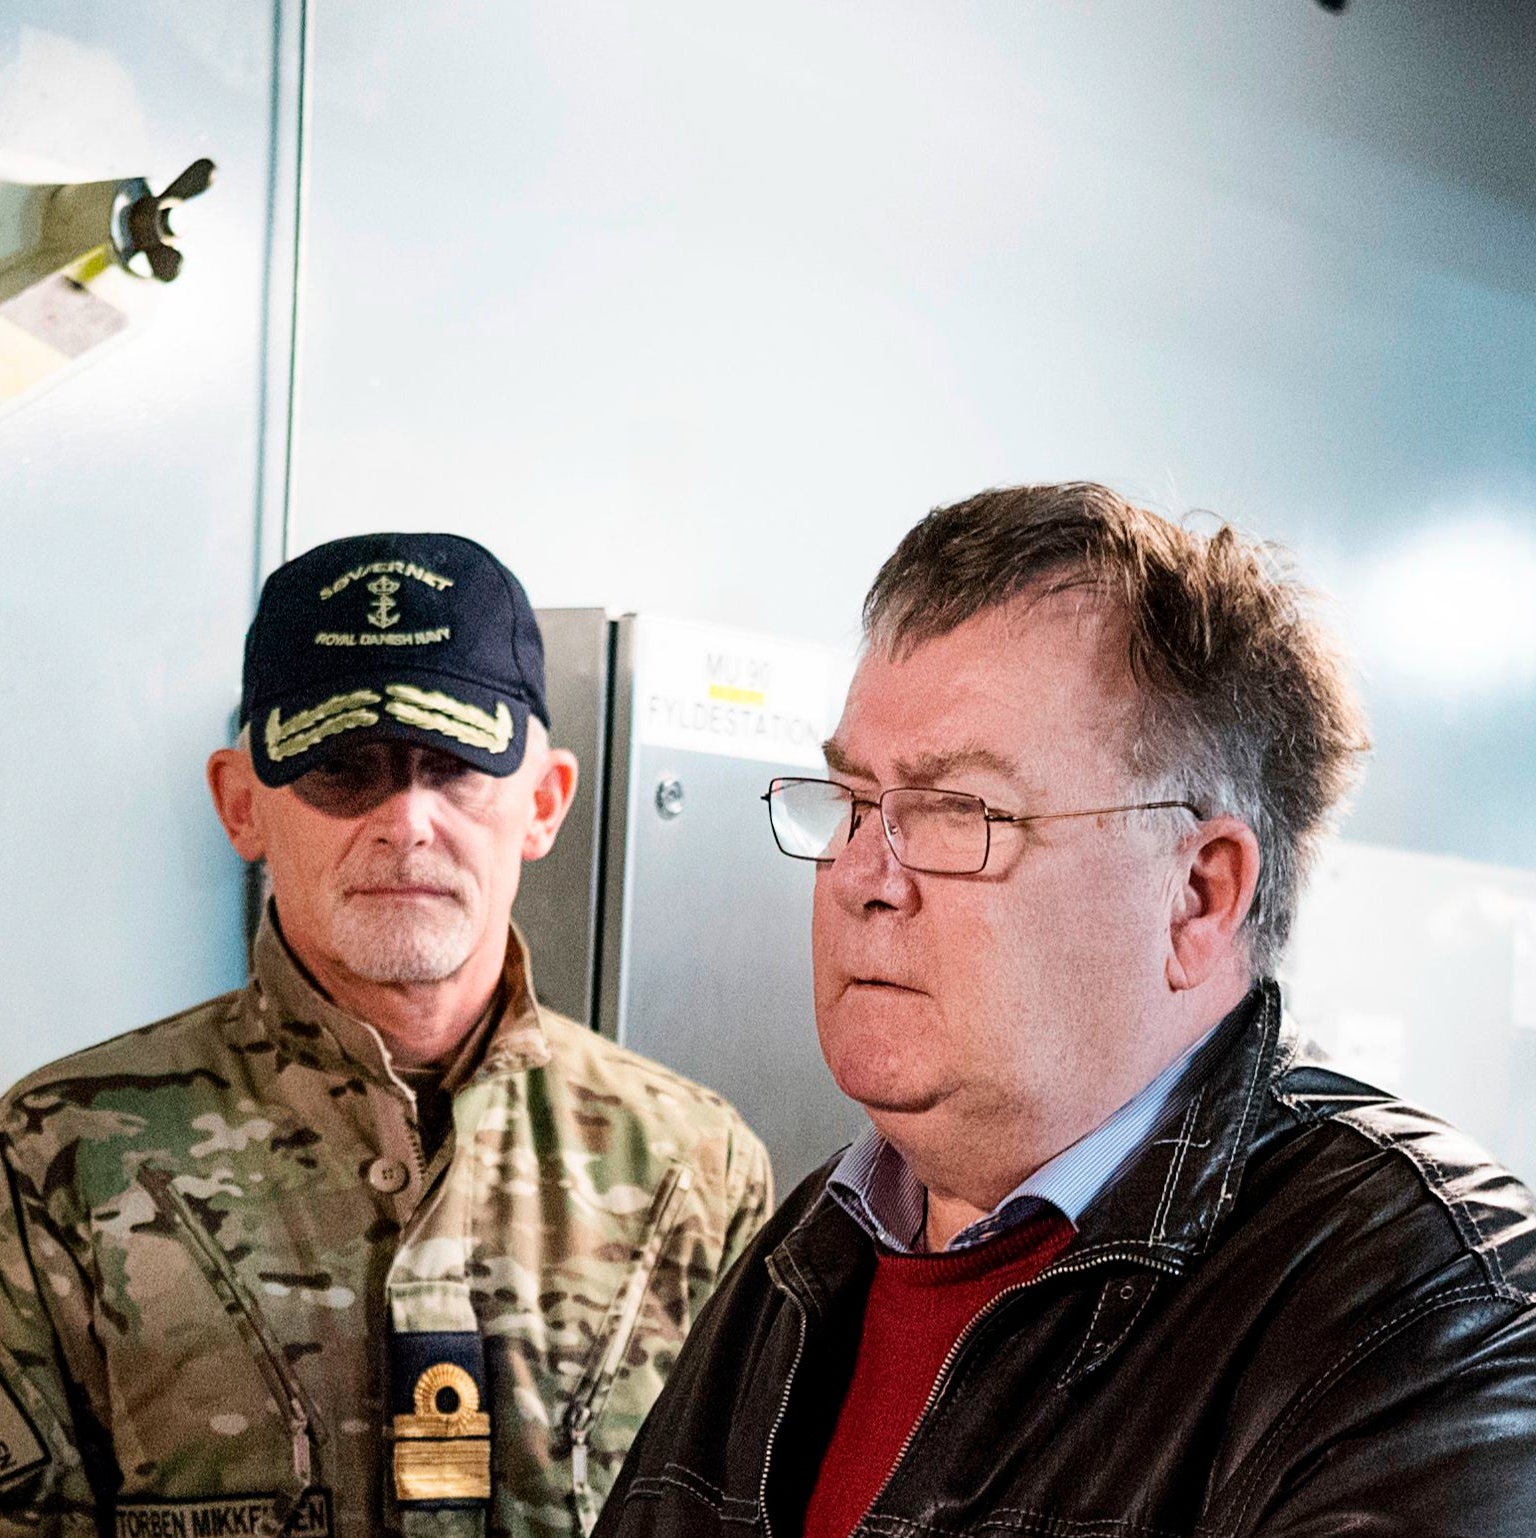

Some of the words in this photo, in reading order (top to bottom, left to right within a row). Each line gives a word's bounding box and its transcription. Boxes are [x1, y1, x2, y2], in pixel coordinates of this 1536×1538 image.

[315, 632, 357, 646] ROYAL
[360, 632, 413, 646] DANISH
[415, 627, 451, 646] NAVY
